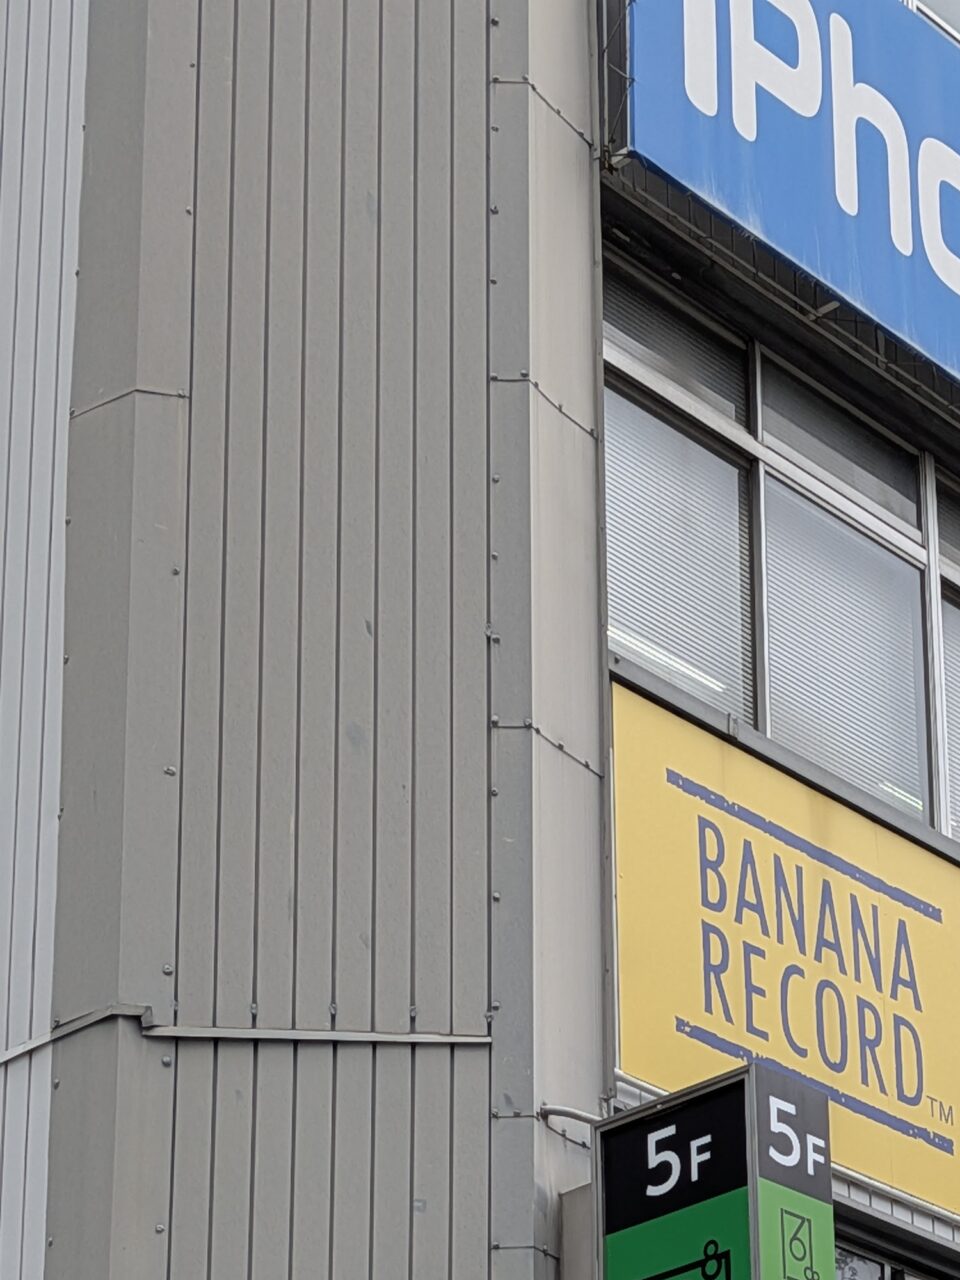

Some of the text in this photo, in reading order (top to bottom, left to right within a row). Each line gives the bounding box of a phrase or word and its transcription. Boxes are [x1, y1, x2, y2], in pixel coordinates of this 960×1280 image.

[698, 814, 924, 1013] BANANA
[646, 1124, 713, 1198] 5F
[768, 1095, 826, 1177] 5F
